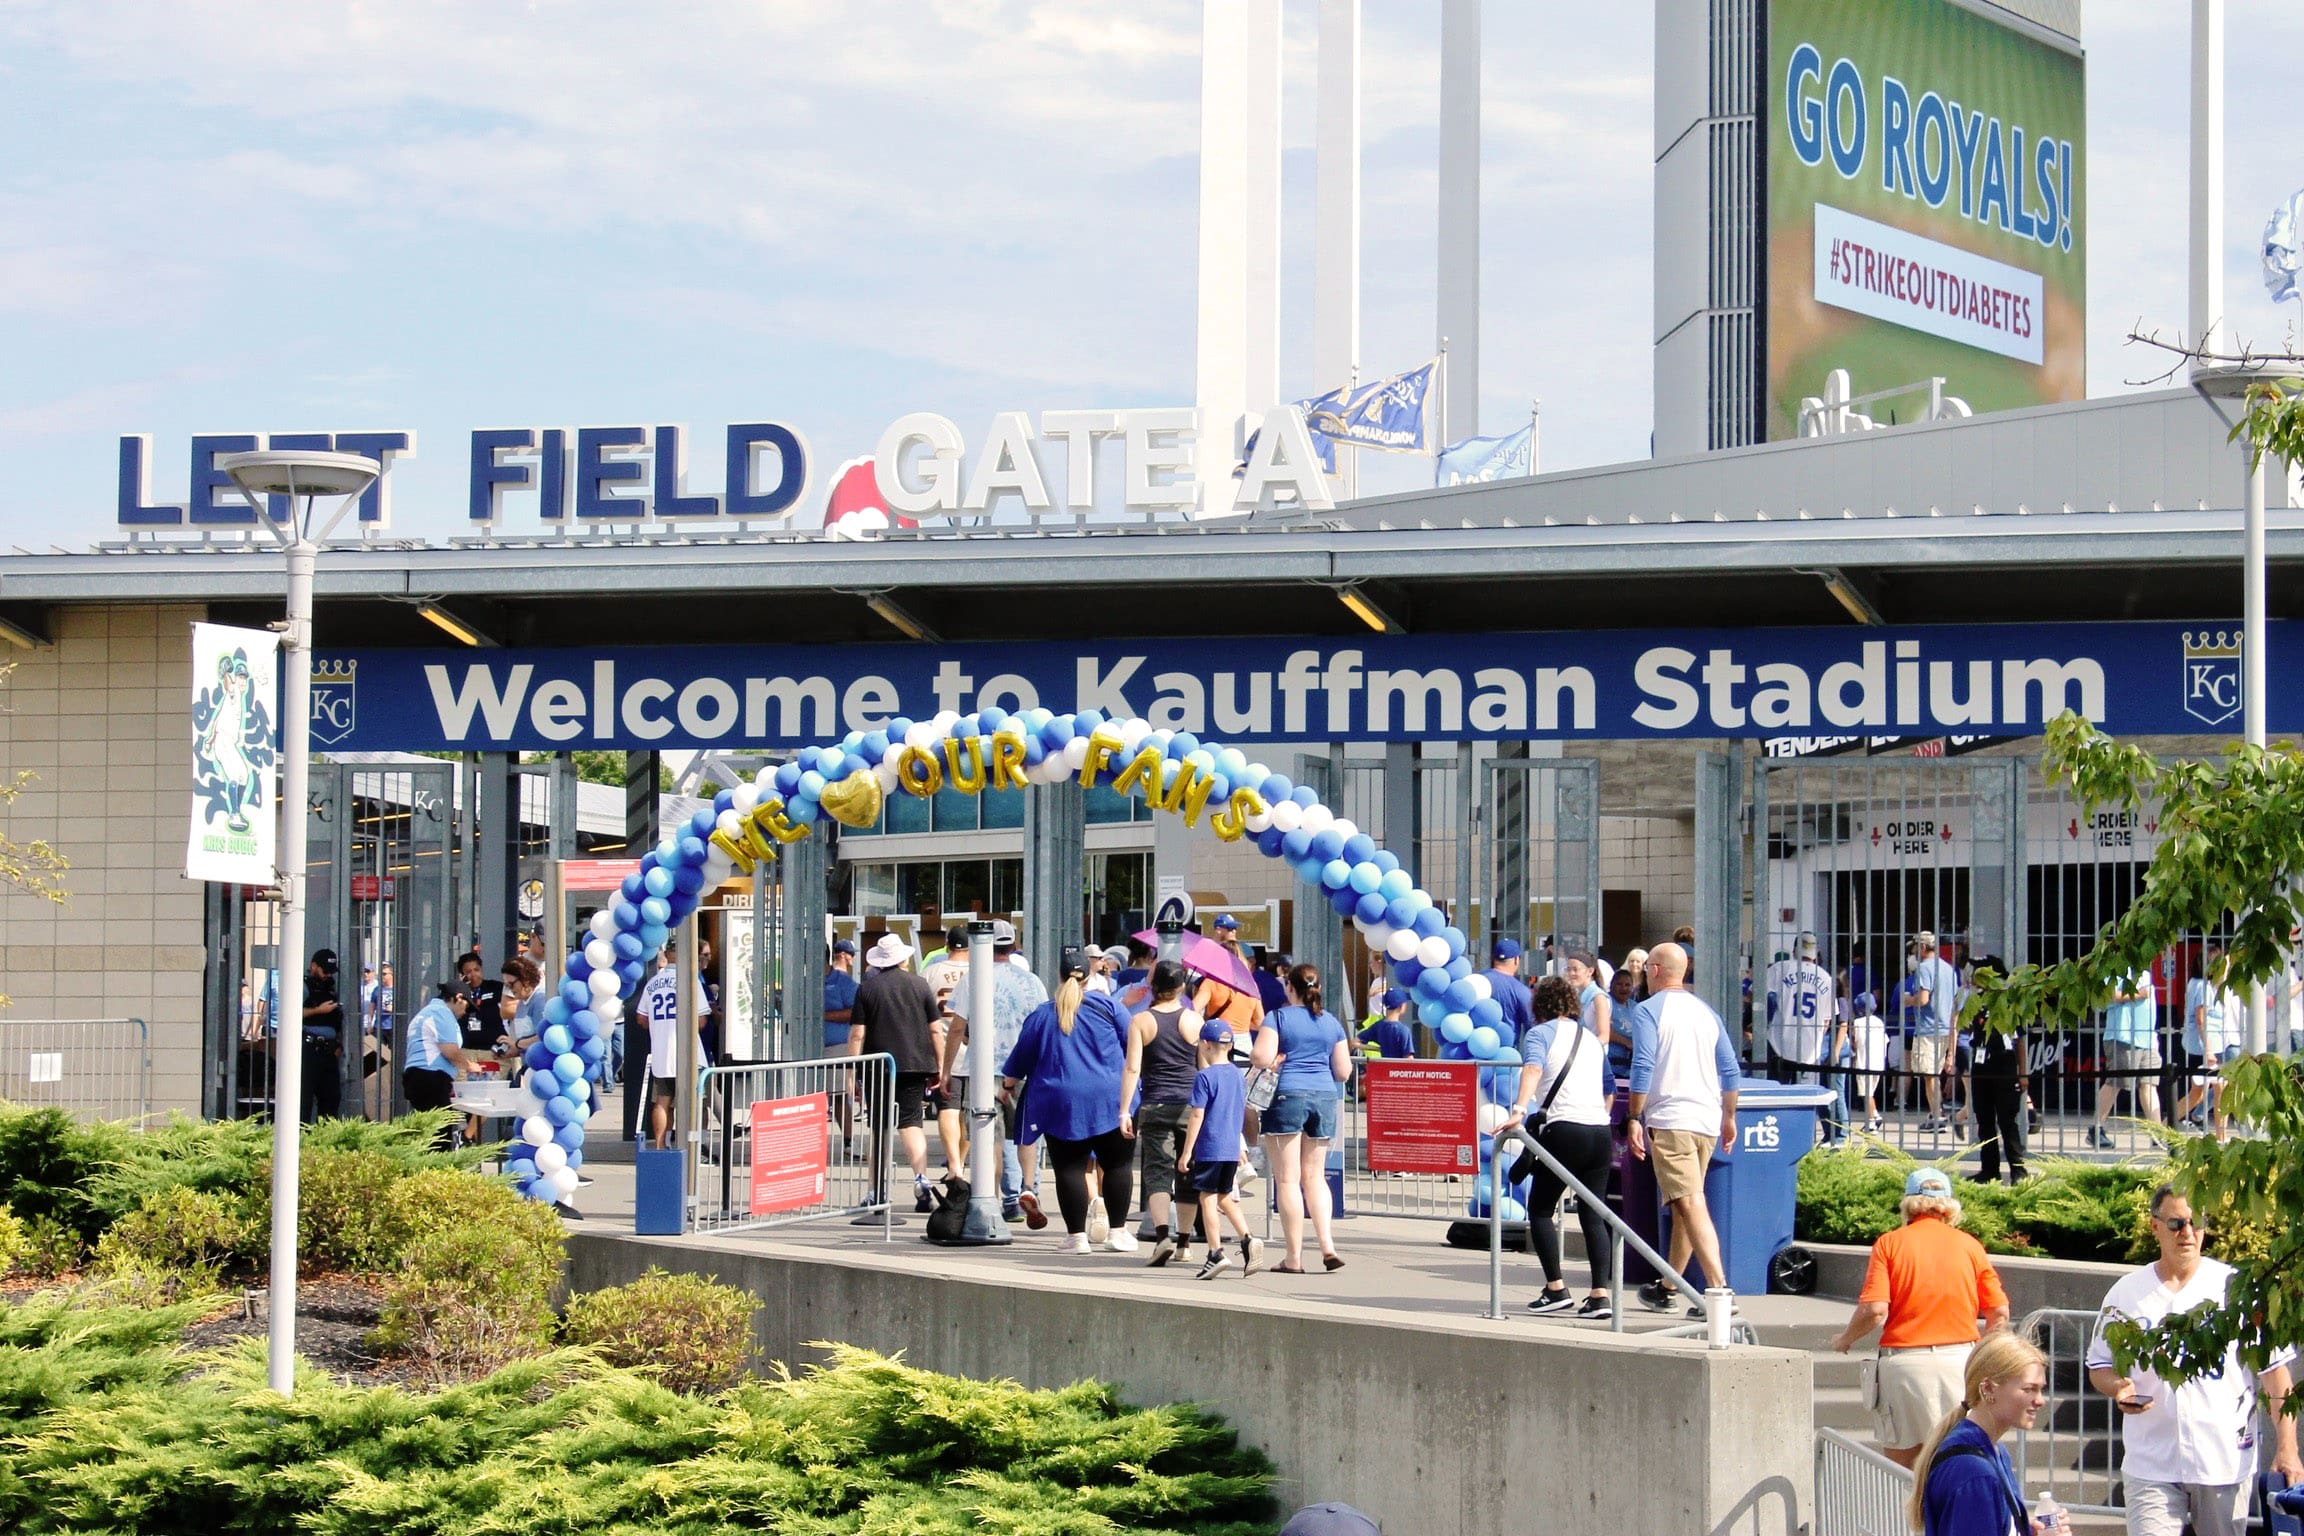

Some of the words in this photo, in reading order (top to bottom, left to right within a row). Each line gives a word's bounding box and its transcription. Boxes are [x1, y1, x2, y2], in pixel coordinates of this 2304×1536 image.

[1786, 42, 1867, 179] GO
[1882, 76, 2073, 254] ROYALS!
[1830, 237, 2032, 339] #STRIKEOUTDIABETES
[468, 422, 808, 525] FIELD
[874, 406, 1203, 512] GATE
[1232, 405, 1336, 511] A
[423, 659, 900, 740] Welcome
[932, 660, 1040, 714] to
[1077, 649, 1597, 734] Kauffman
[1631, 639, 2106, 730] Stadium
[2190, 665, 2237, 707] KC
[311, 690, 350, 729] KC
[1765, 736, 1858, 757] TENDE
[708, 797, 810, 874] WE
[897, 731, 1031, 798] OUR
[1077, 731, 1265, 842] FANS
[1782, 971, 1829, 995] MERIFIELD
[652, 993, 677, 1020] 22
[1793, 991, 1816, 1019] 15
[1744, 1121, 1780, 1147] rts
